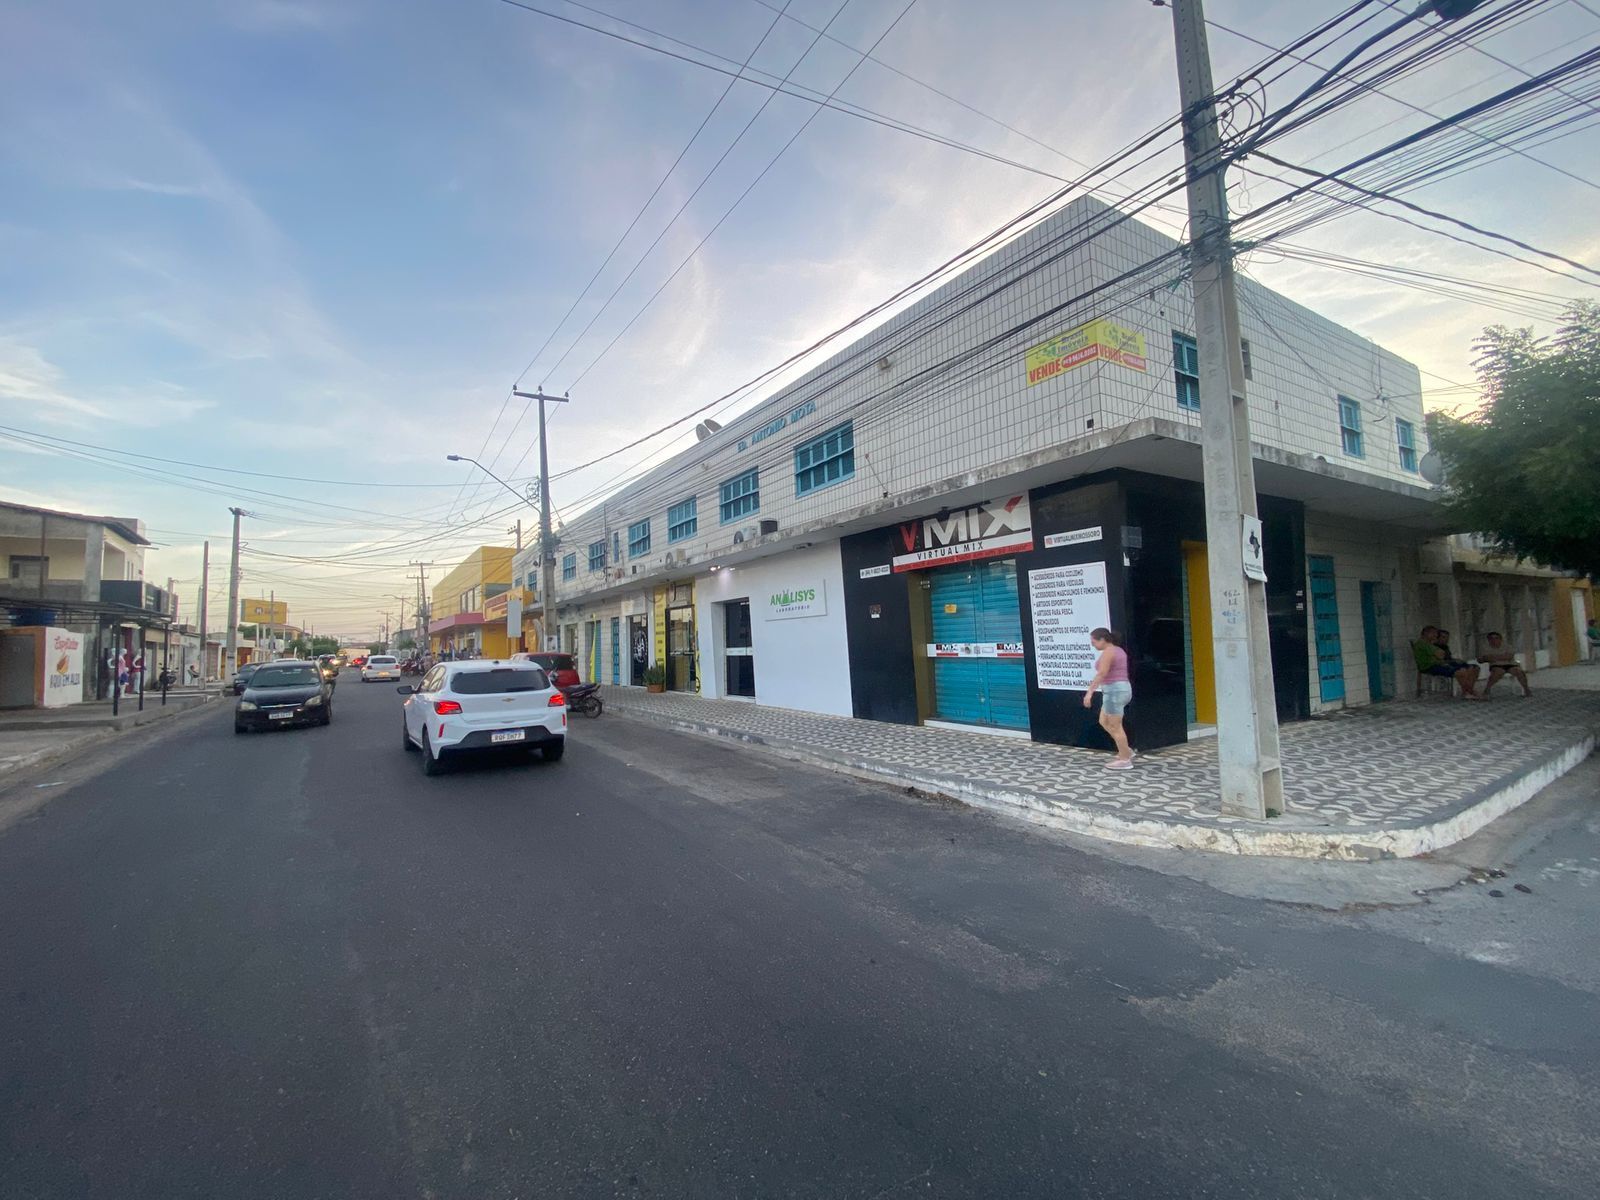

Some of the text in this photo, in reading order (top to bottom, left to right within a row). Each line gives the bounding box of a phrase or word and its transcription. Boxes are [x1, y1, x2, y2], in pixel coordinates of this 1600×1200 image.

[1029, 358, 1062, 382] VENDE
[917, 546, 958, 560] VIRTUAL
[964, 542, 984, 552] MIX
[1084, 586, 1104, 594] FEMININOS
[1069, 624, 1089, 635] PROTEÇÃO
